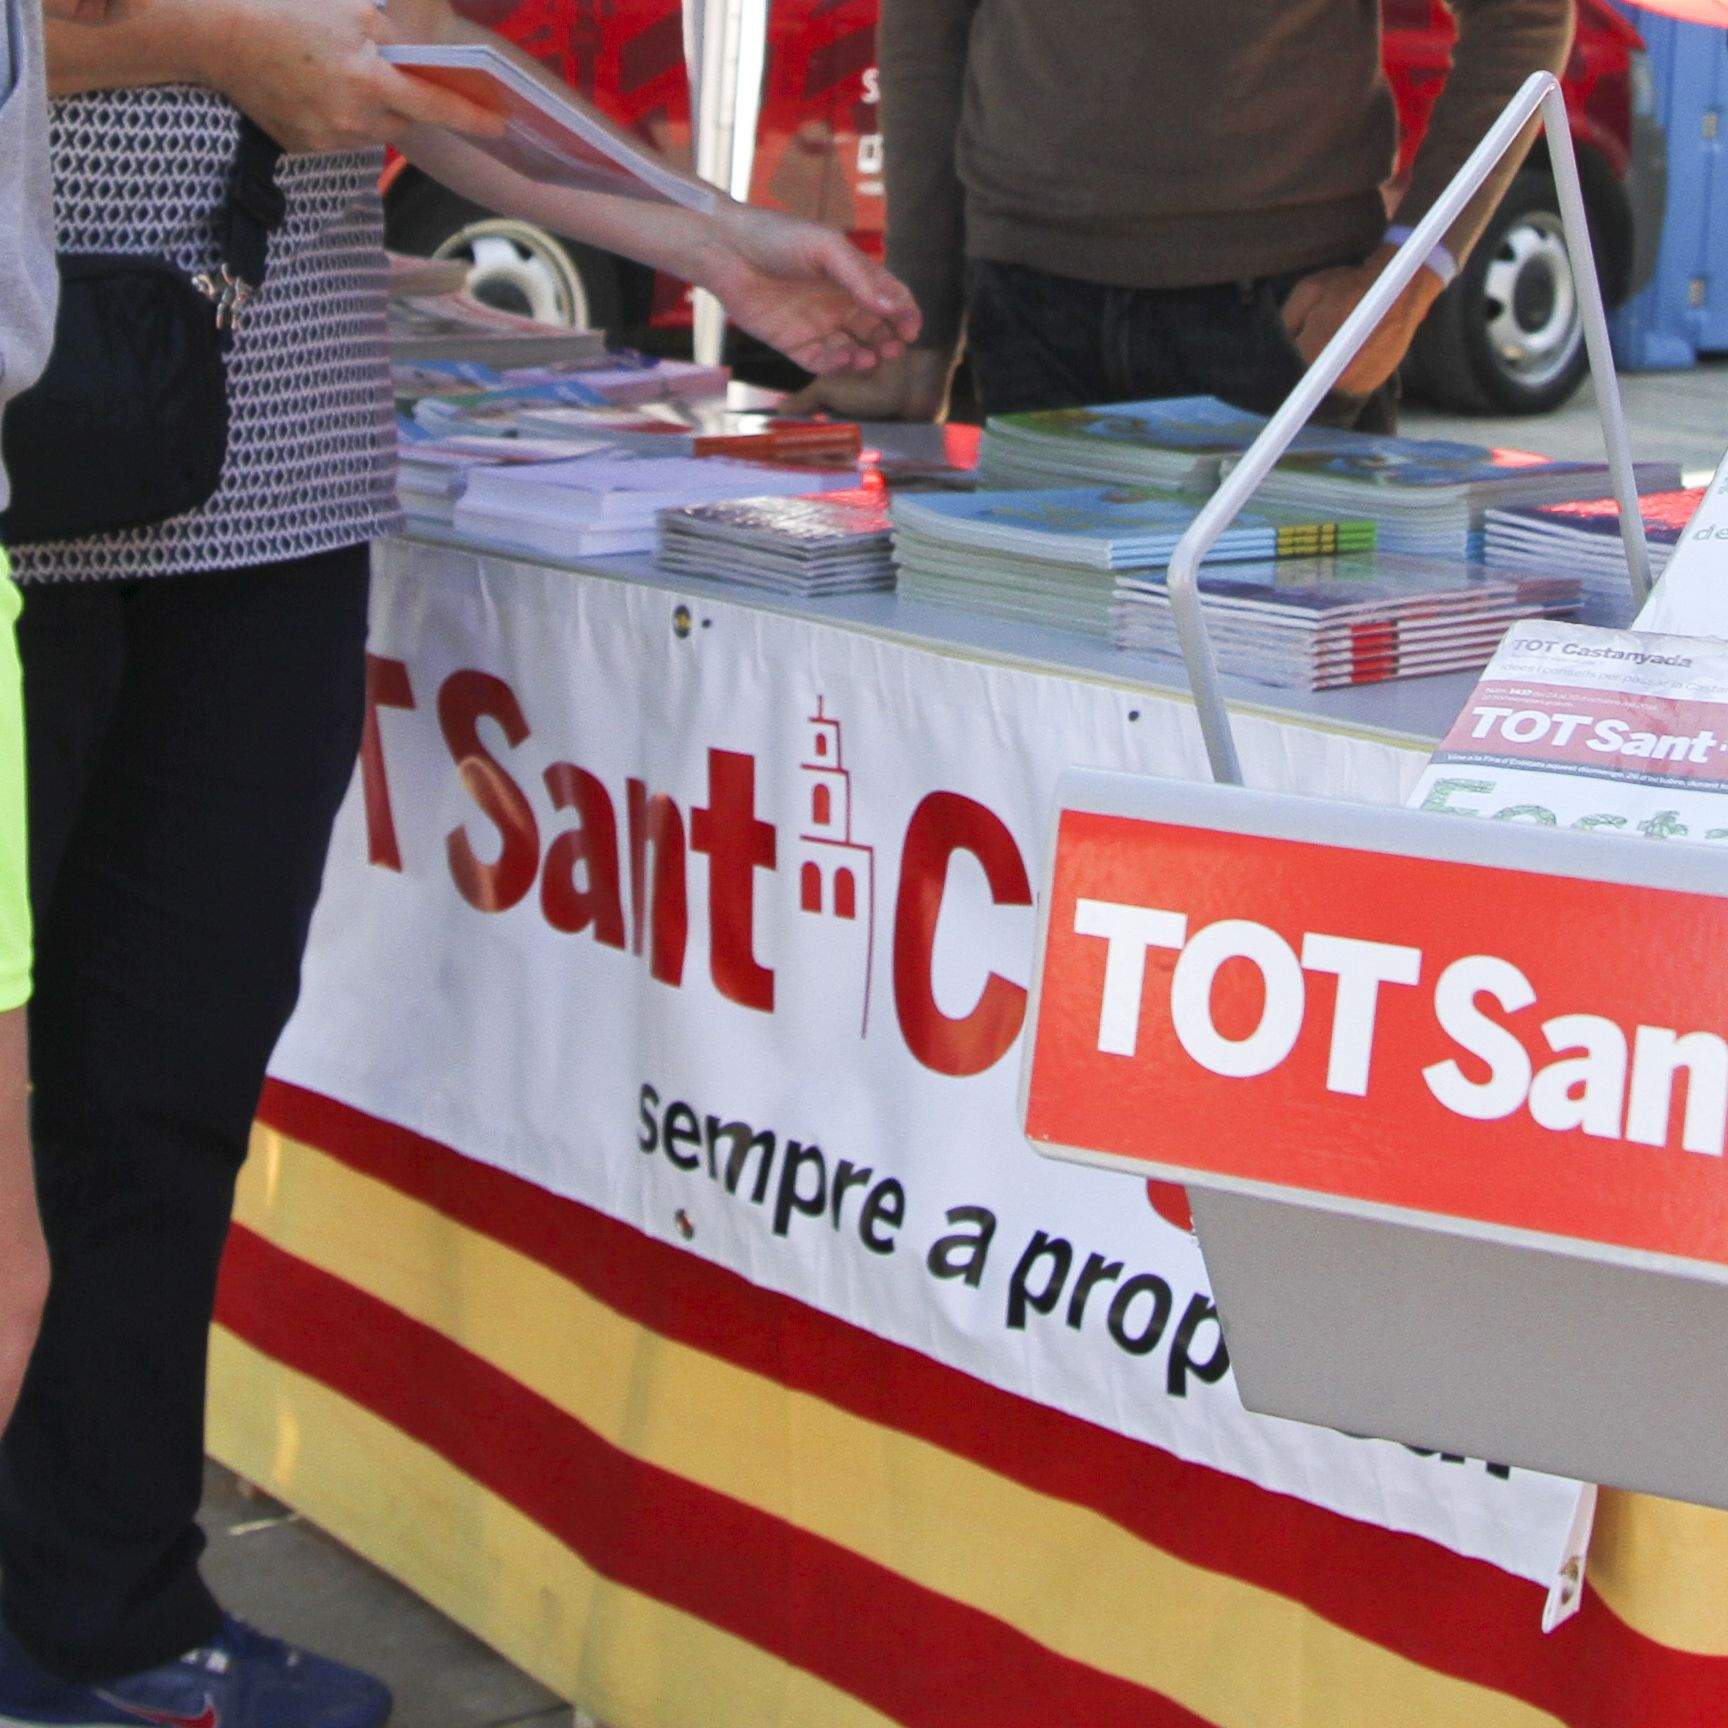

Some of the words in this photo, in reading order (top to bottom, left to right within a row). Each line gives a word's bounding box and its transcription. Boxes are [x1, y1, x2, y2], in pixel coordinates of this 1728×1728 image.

[1472, 706, 1594, 747] TOT
[1585, 719, 1716, 764] Sant
[1513, 638, 1560, 652] TOT
[1562, 642, 1693, 668] Castanyada
[436, 667, 778, 1014] Sant
[1073, 898, 1422, 1100] TOT
[638, 1082, 907, 1255] sempre
[927, 1204, 997, 1289] a
[1006, 1229, 1231, 1398] prop
